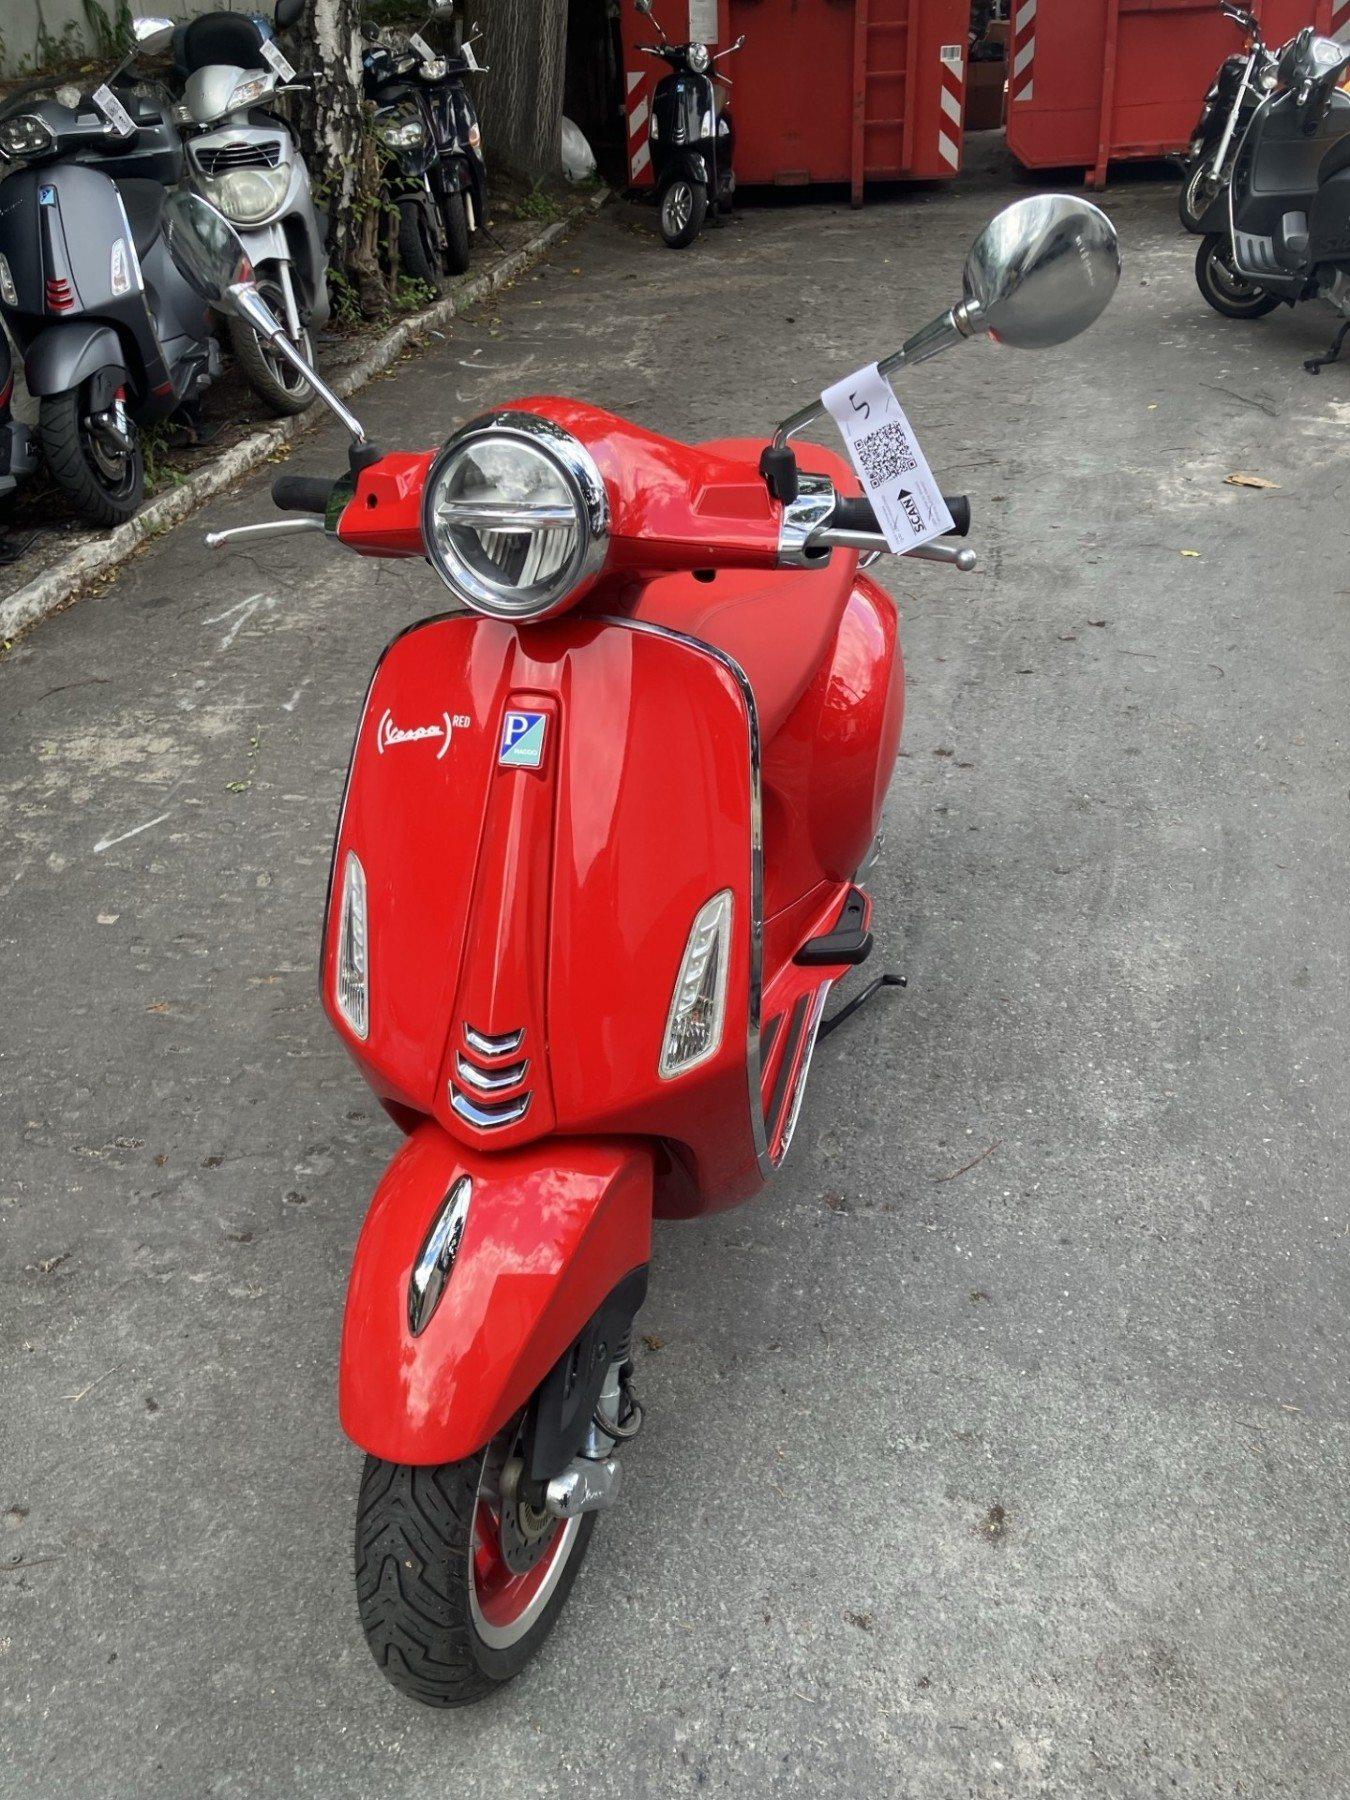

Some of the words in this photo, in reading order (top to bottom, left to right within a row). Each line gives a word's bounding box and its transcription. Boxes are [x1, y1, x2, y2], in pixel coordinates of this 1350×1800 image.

[849, 392, 870, 419] 5
[903, 500, 926, 532] SCAN
[452, 714, 471, 728] RED
[504, 715, 529, 746] P
